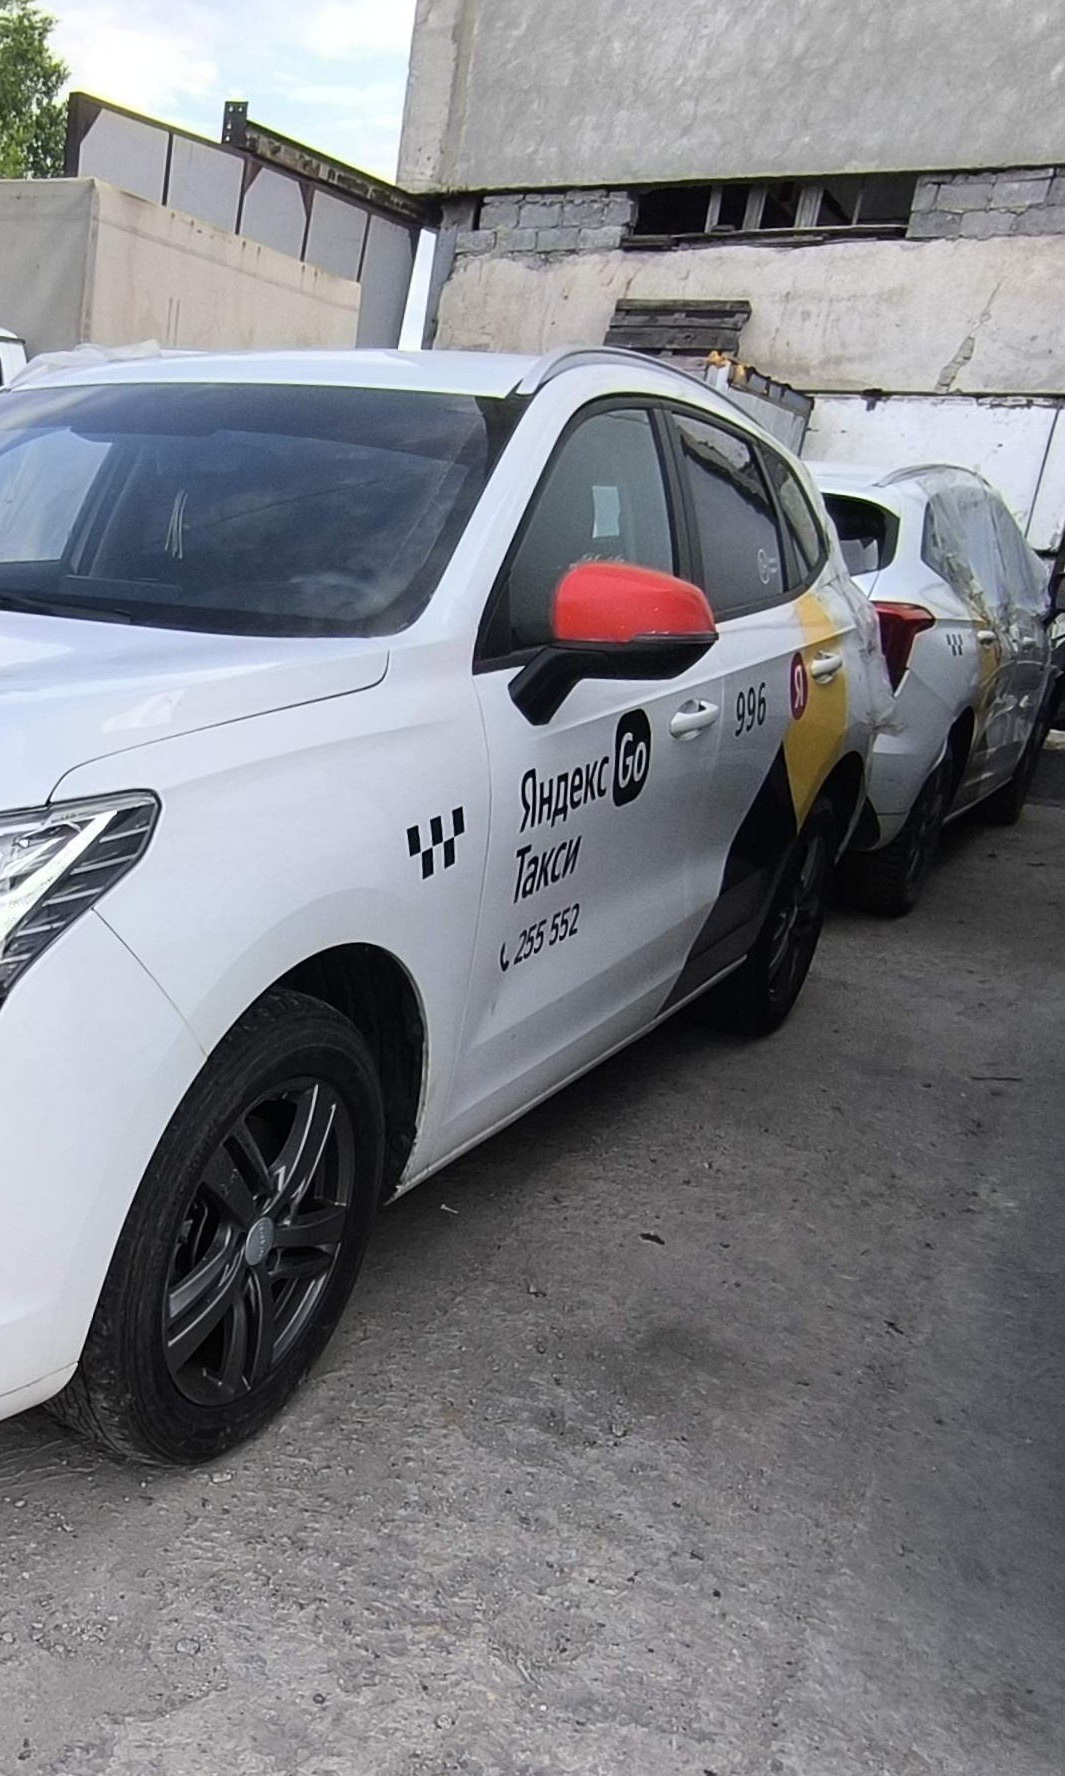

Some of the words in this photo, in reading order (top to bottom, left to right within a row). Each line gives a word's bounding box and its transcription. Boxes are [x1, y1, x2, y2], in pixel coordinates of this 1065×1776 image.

[735, 682, 766, 737] 996
[519, 756, 610, 833] Яндекс
[618, 732, 647, 789] Go
[513, 835, 582, 904] Такси
[513, 918, 547, 965] 255
[548, 903, 580, 946] 552
